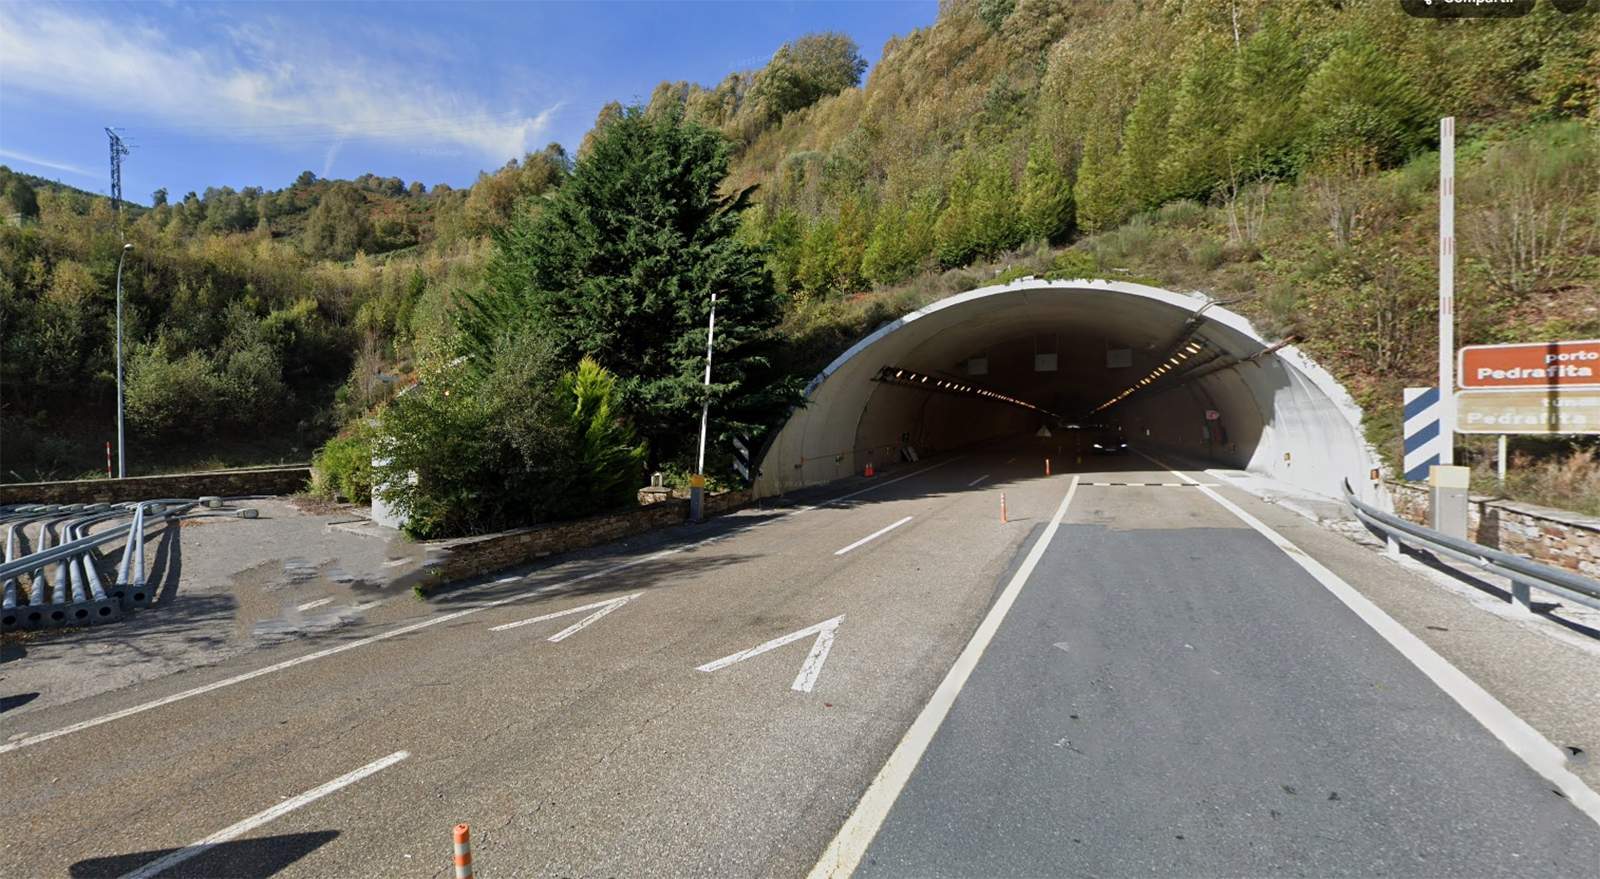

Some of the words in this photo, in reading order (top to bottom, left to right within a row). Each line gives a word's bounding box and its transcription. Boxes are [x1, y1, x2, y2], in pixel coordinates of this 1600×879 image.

[1545, 351, 1599, 363] porto
[1477, 366, 1592, 380] Pedrafita
[1467, 411, 1587, 424] Pedrafita
